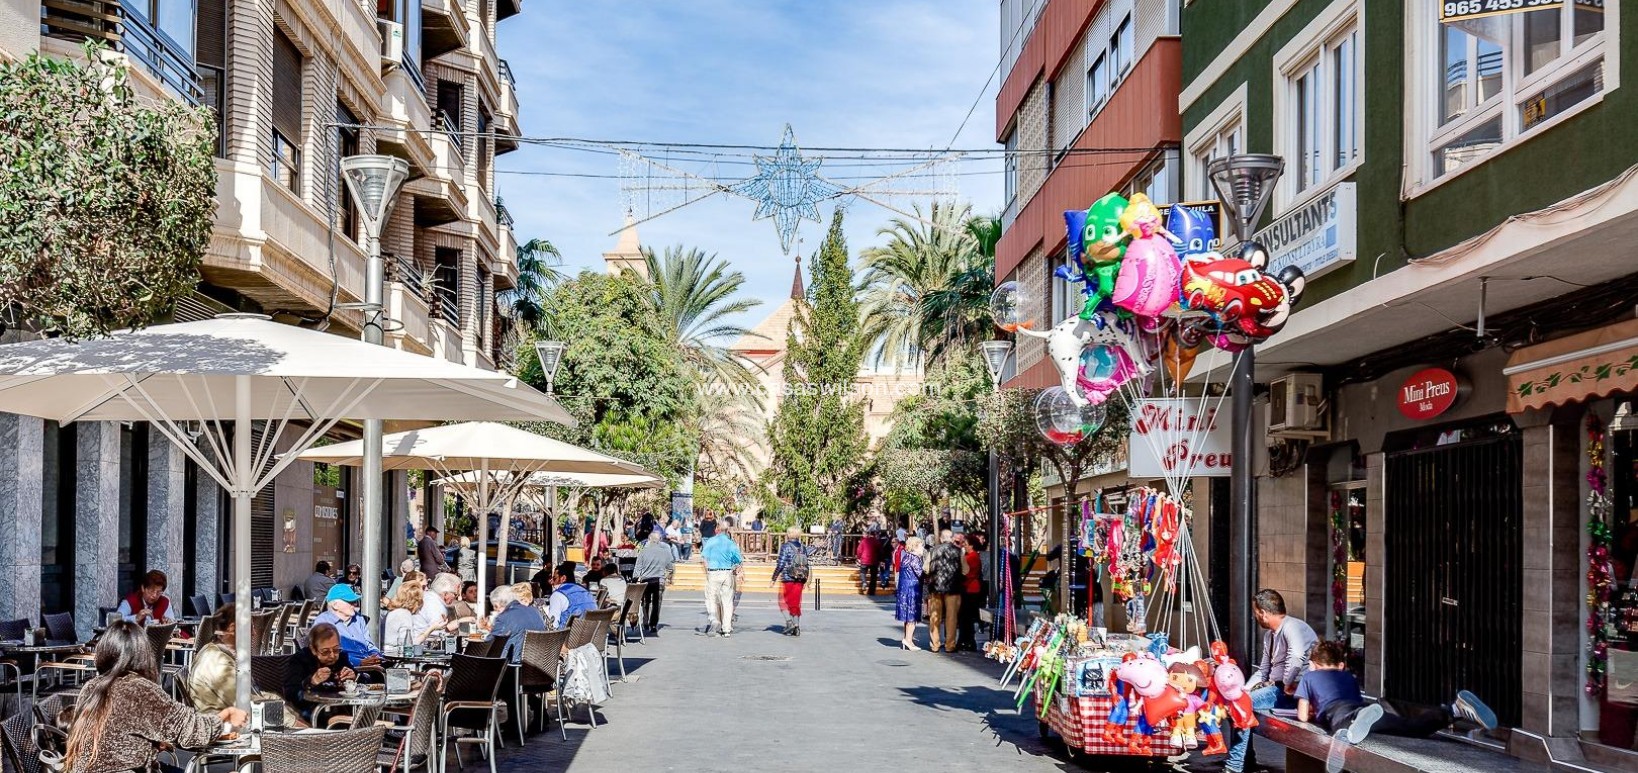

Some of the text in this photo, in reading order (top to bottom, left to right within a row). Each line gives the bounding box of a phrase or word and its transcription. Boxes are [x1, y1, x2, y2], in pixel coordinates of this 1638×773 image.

[1444, 0, 1482, 17] 965
[1403, 380, 1450, 404] Mini Preus
[1135, 402, 1218, 435] Mini
